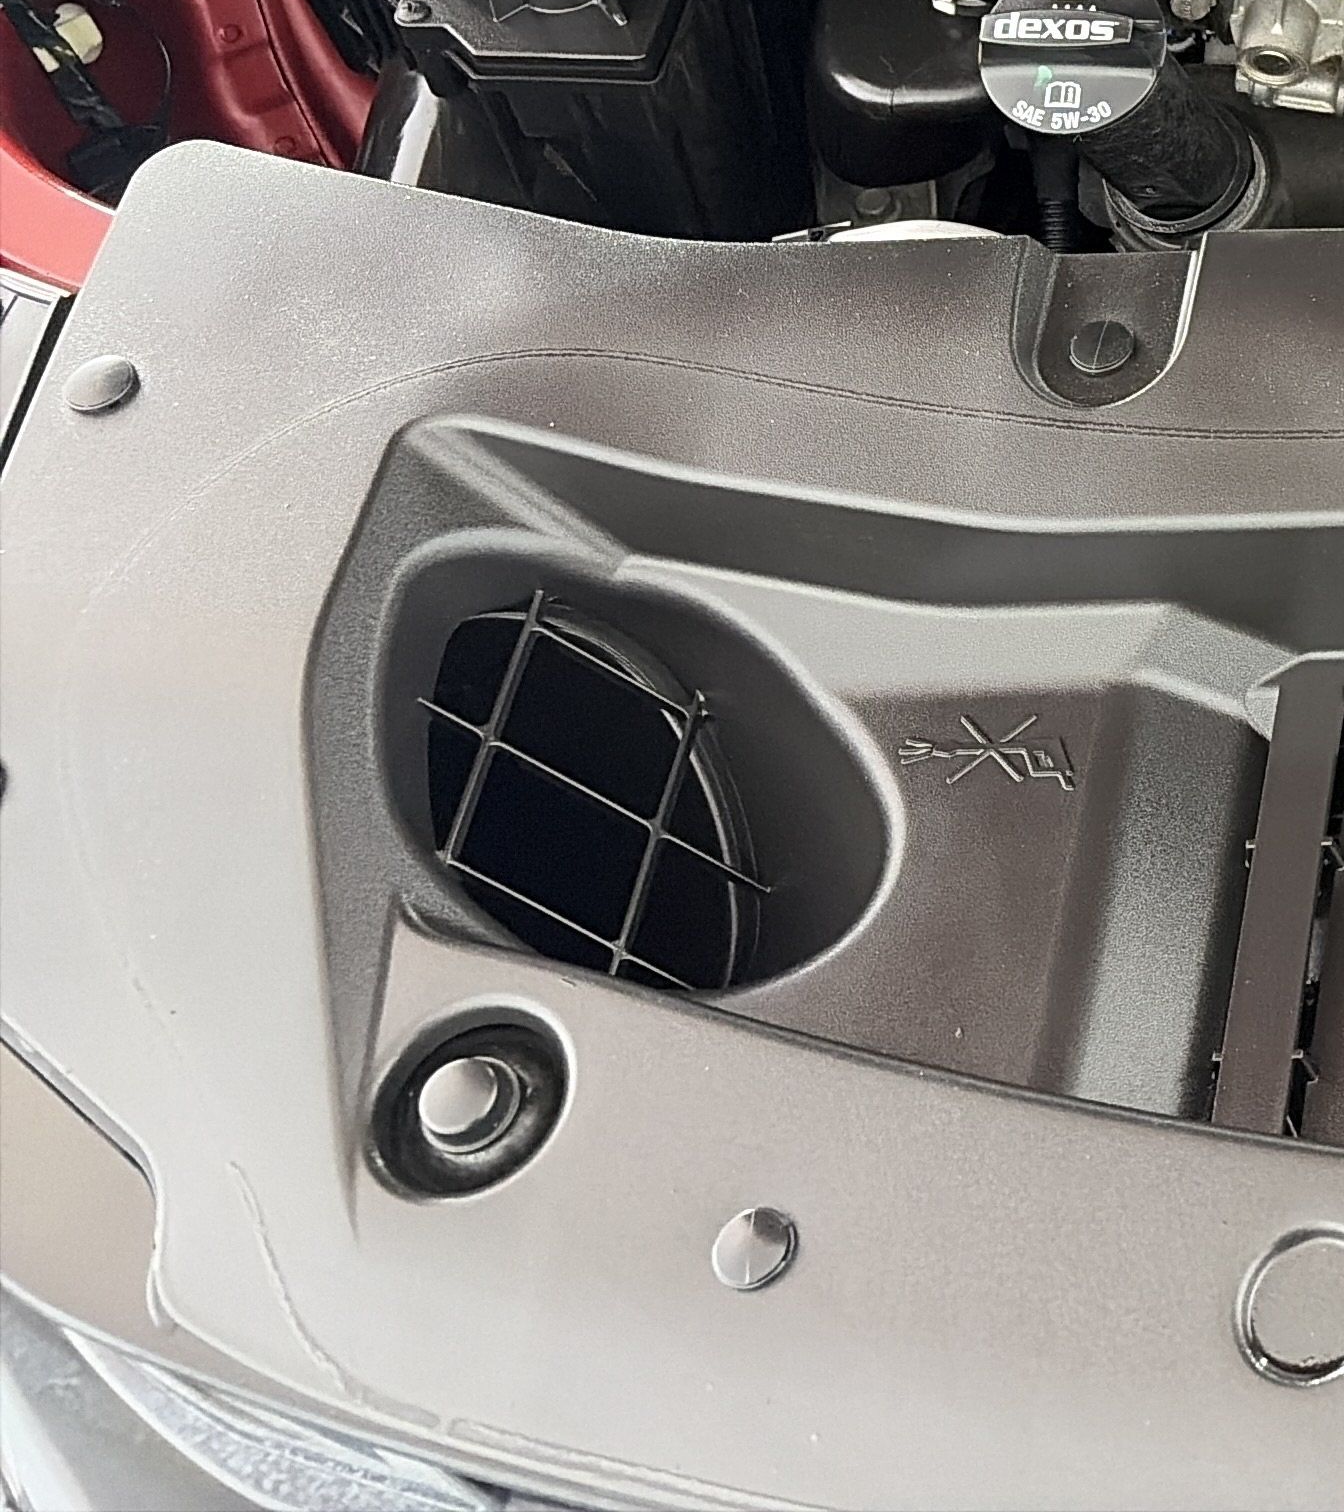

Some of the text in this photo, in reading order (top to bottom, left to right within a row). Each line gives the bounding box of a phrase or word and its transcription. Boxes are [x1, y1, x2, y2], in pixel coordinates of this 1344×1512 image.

[993, 11, 1116, 41] dexos
[1011, 99, 1113, 130] SAE 5W-30
